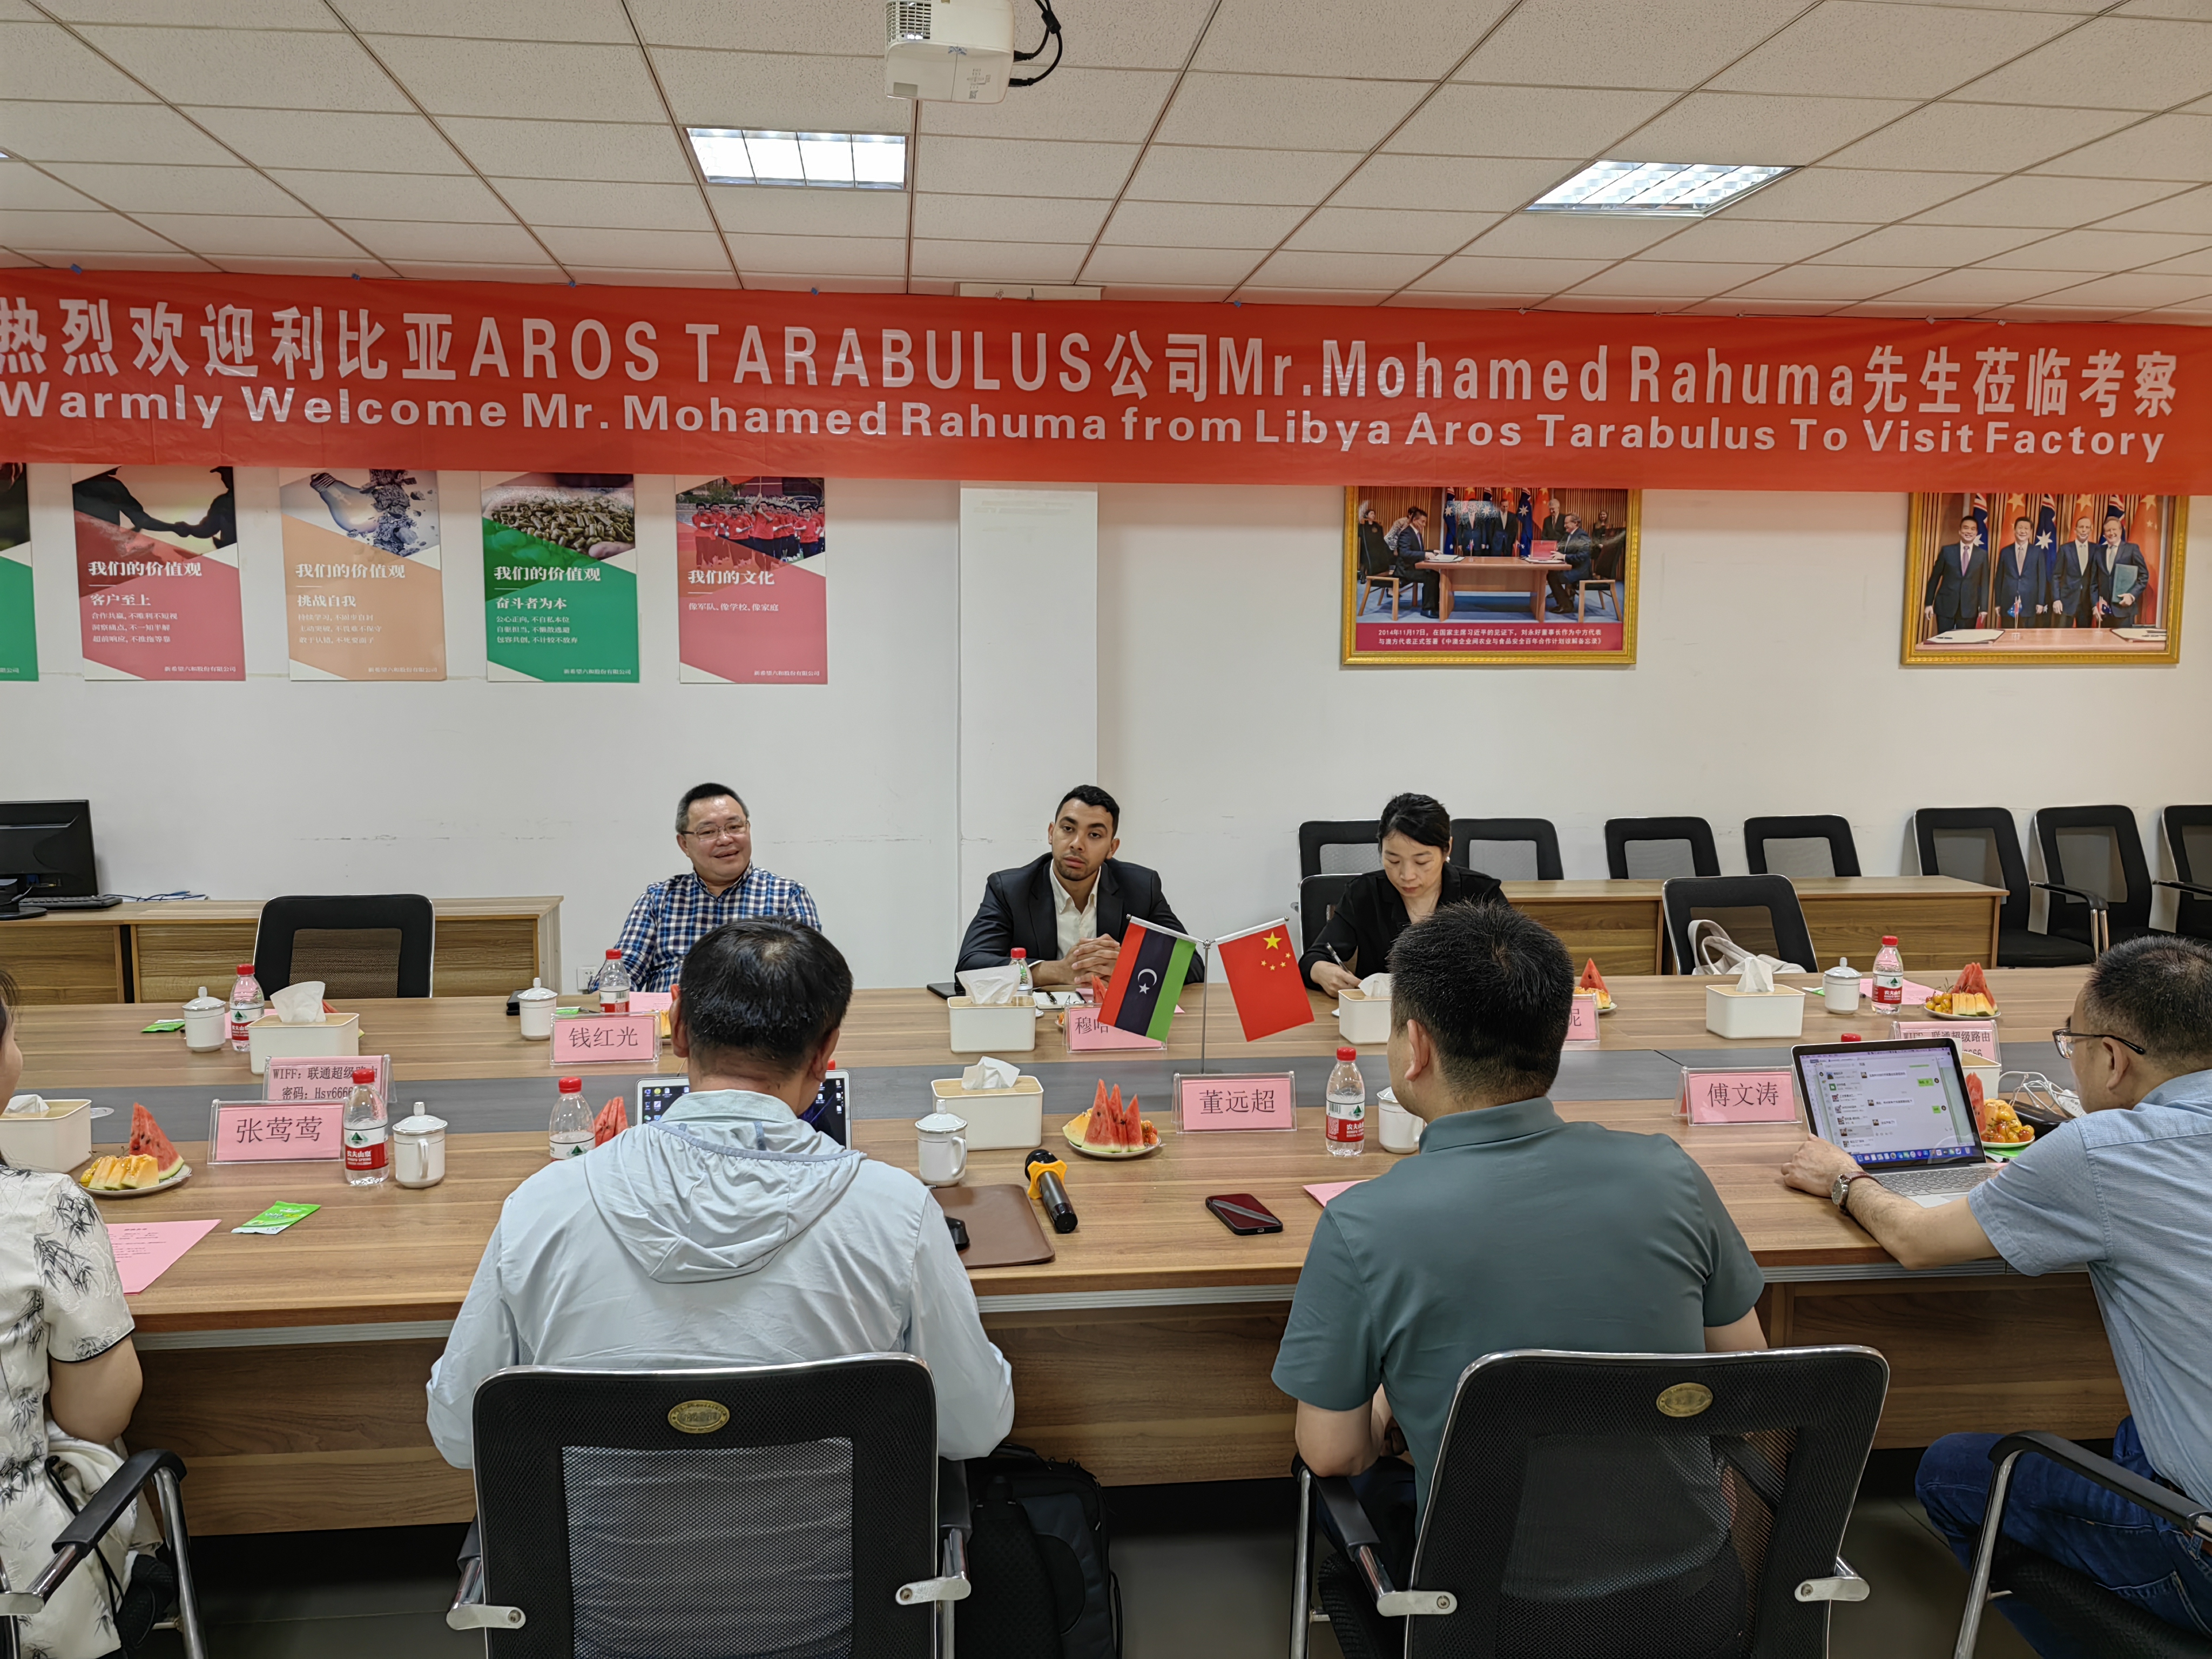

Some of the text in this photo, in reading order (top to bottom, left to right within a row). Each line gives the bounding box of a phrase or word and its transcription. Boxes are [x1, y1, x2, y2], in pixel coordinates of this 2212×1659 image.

[0, 381, 2164, 462] Warmly Welcome Mr. Mohamed Rahuma from Libya Aros Tarabulus To Visit Factory
[88, 561, 202, 577] 我们的价值观
[295, 563, 406, 579] 我们的价值观
[494, 566, 601, 582] 我们的价值观
[687, 570, 775, 585] 我们的文化
[90, 594, 151, 606] 客户至上
[297, 595, 356, 608] 挑战自我
[496, 597, 567, 610] 奋斗者为本
[569, 1027, 638, 1048] 钱红光
[1199, 1089, 1276, 1115] 董远超
[1707, 1082, 1779, 1108] 傅文涛
[236, 1116, 322, 1144] 张莺莺
